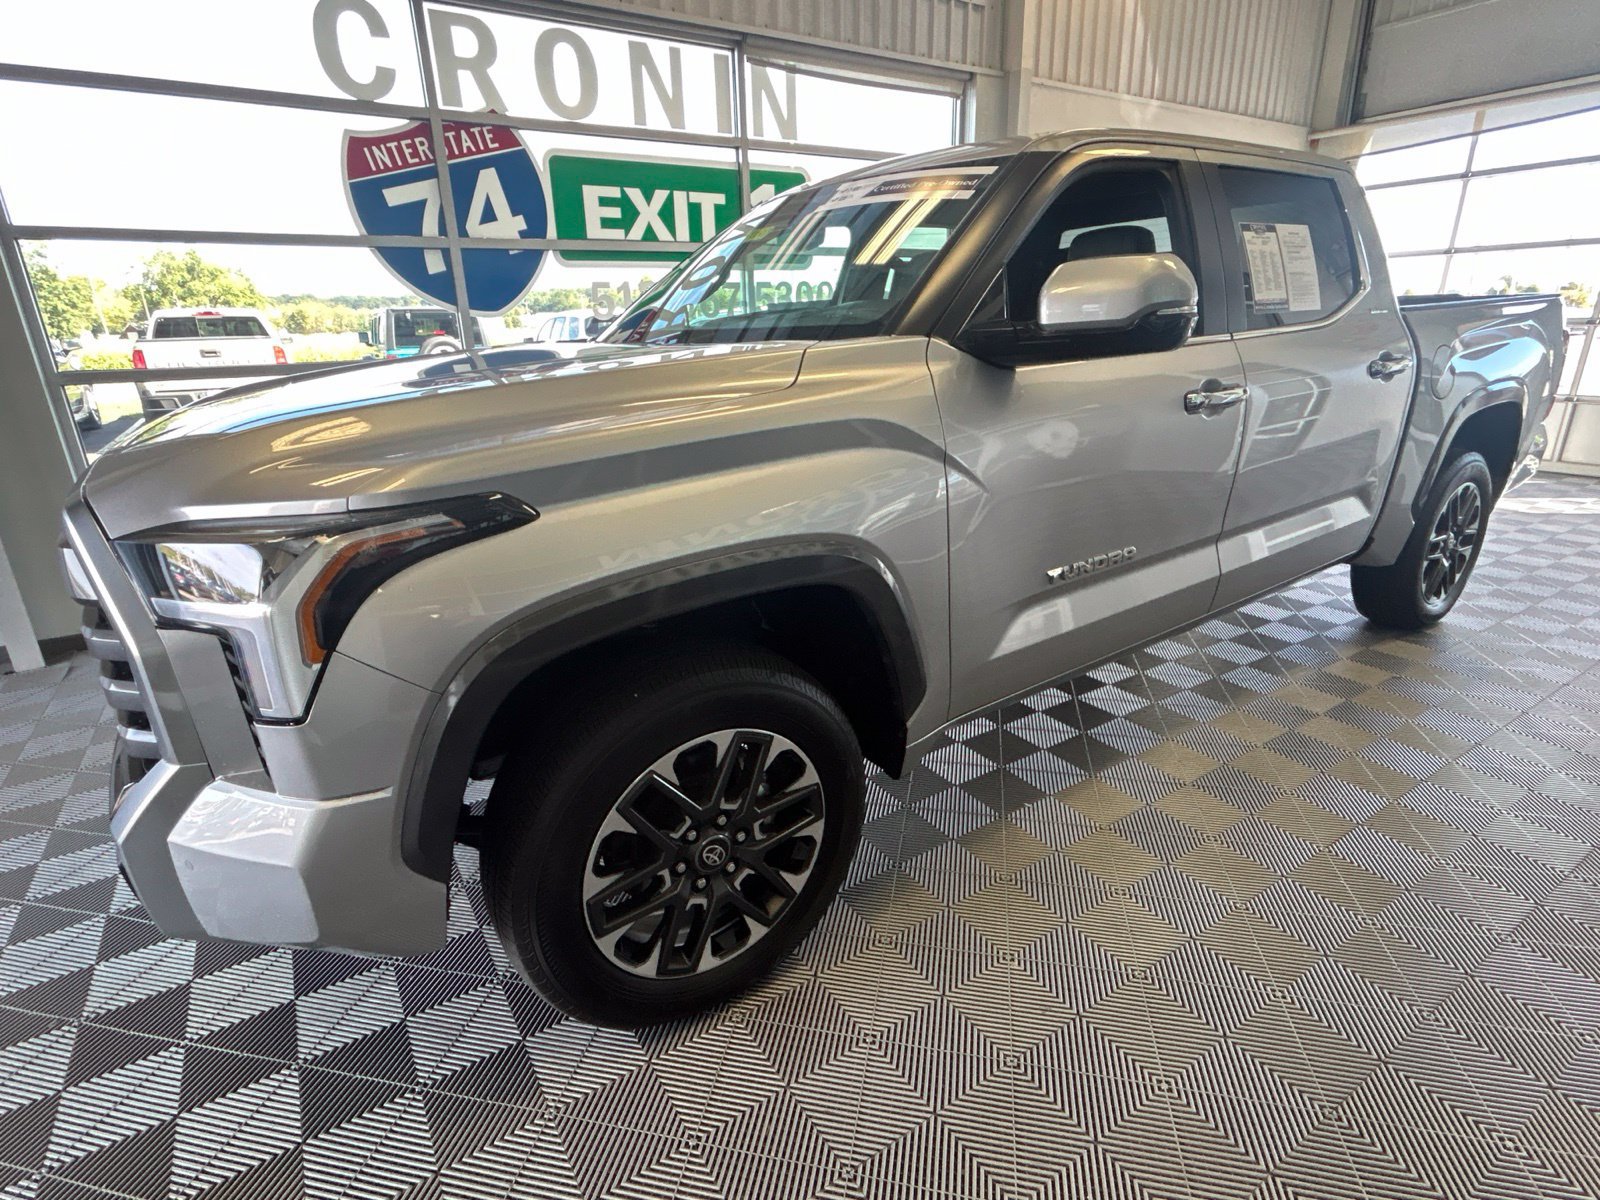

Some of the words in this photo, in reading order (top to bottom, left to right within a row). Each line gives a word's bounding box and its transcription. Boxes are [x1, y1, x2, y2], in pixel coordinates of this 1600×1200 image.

[313, 0, 797, 140] CRONIN
[363, 126, 500, 171] INTERTATE
[382, 167, 528, 274] 74
[582, 184, 726, 243] EXIT
[1046, 545, 1137, 584] TUNDRA
